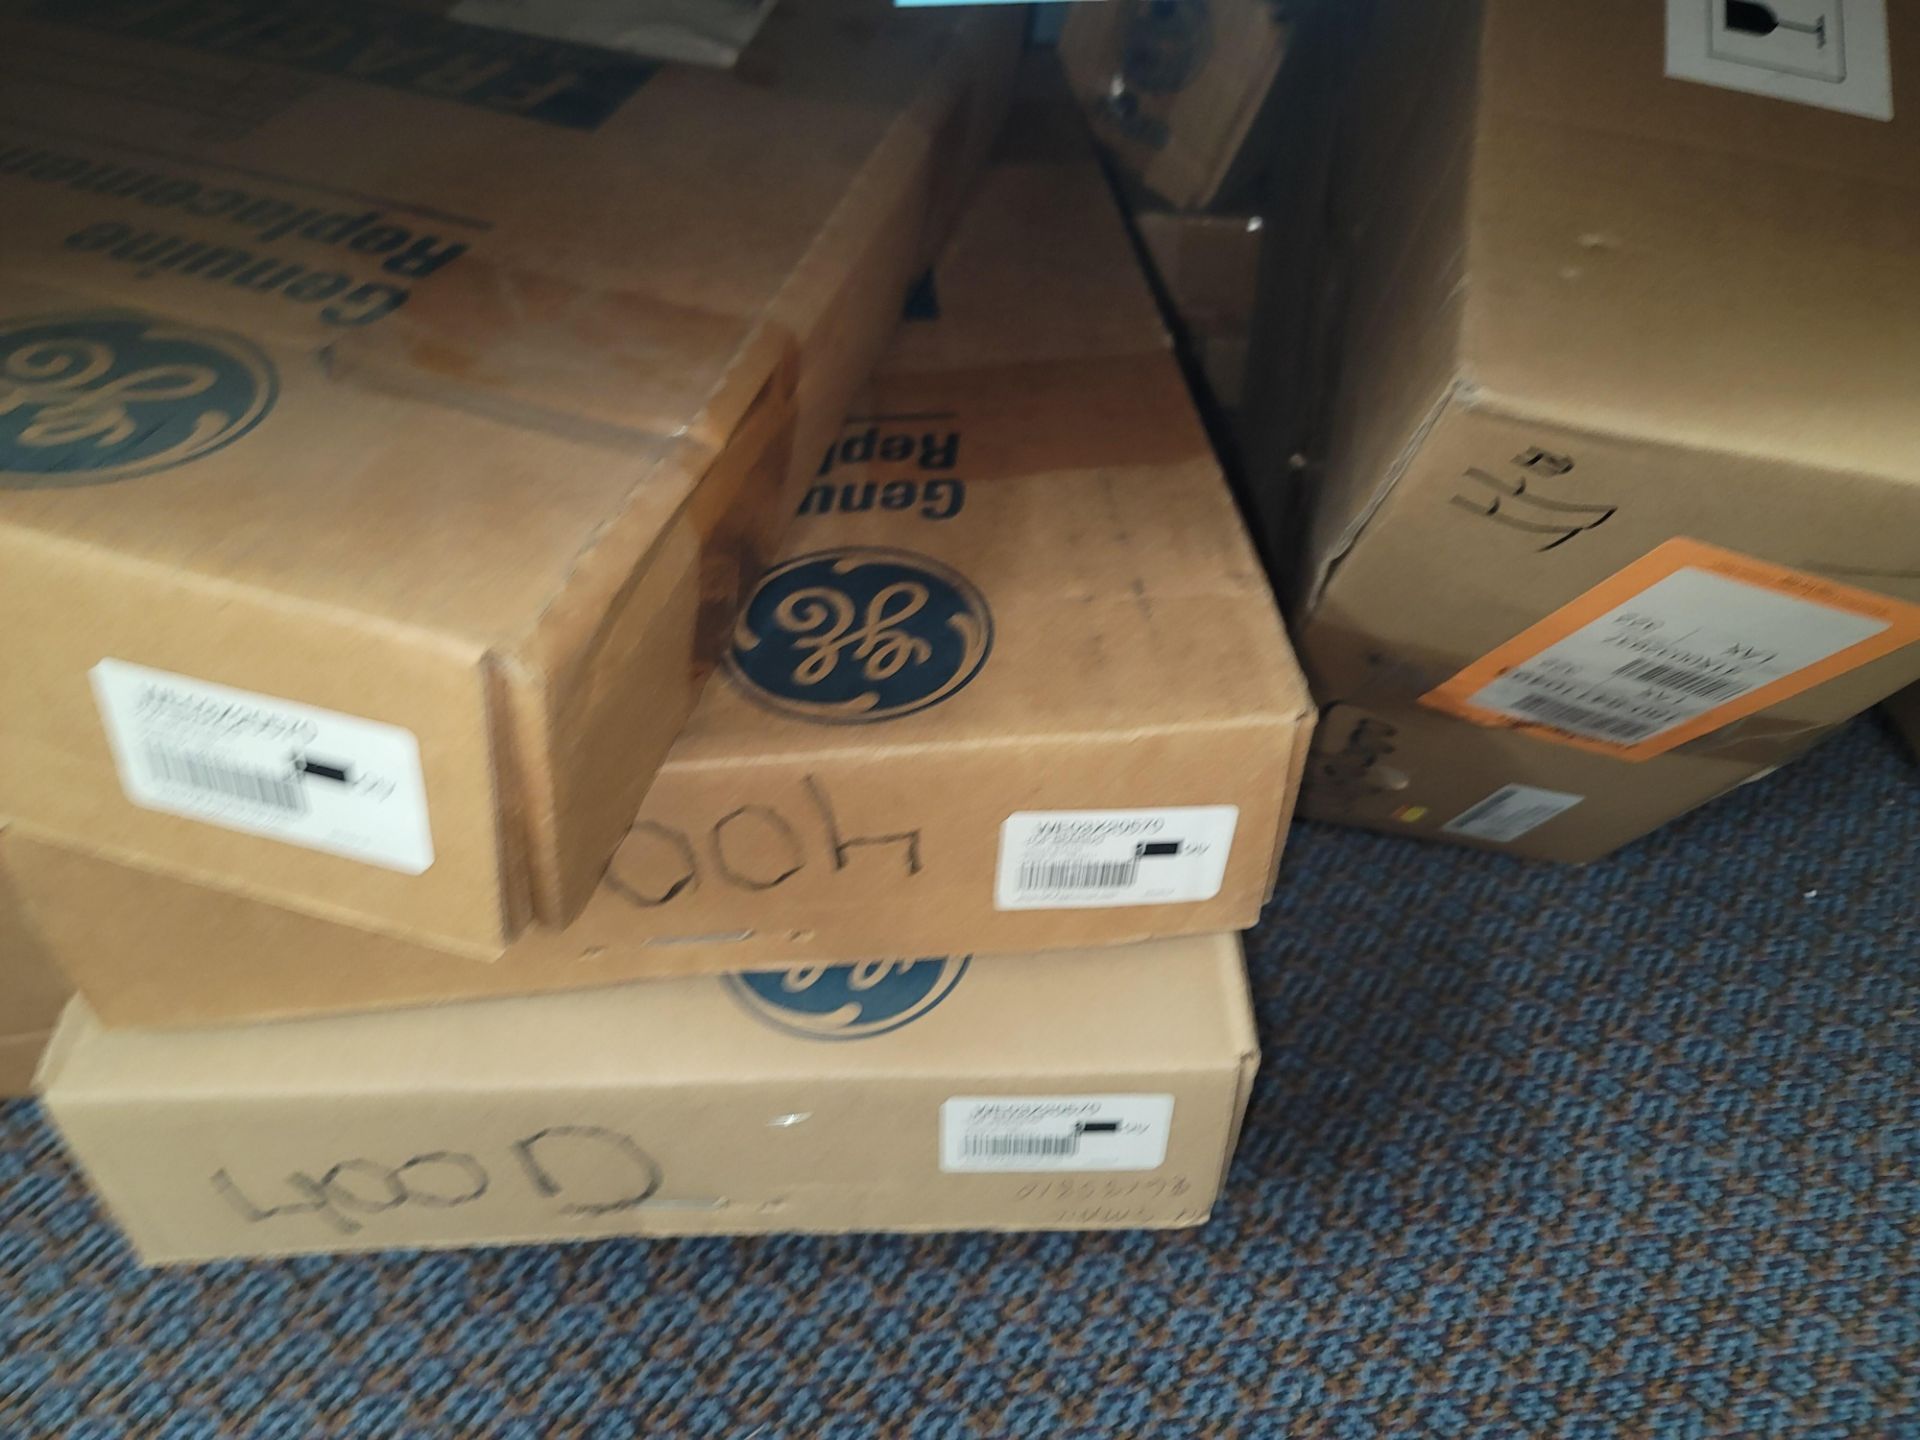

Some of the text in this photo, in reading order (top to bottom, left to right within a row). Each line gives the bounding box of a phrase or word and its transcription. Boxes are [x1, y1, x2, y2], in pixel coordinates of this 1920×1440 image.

[65, 221, 410, 328] Genuine
[816, 428, 961, 476] Repl
[210, 1125, 663, 1234] 400 D
